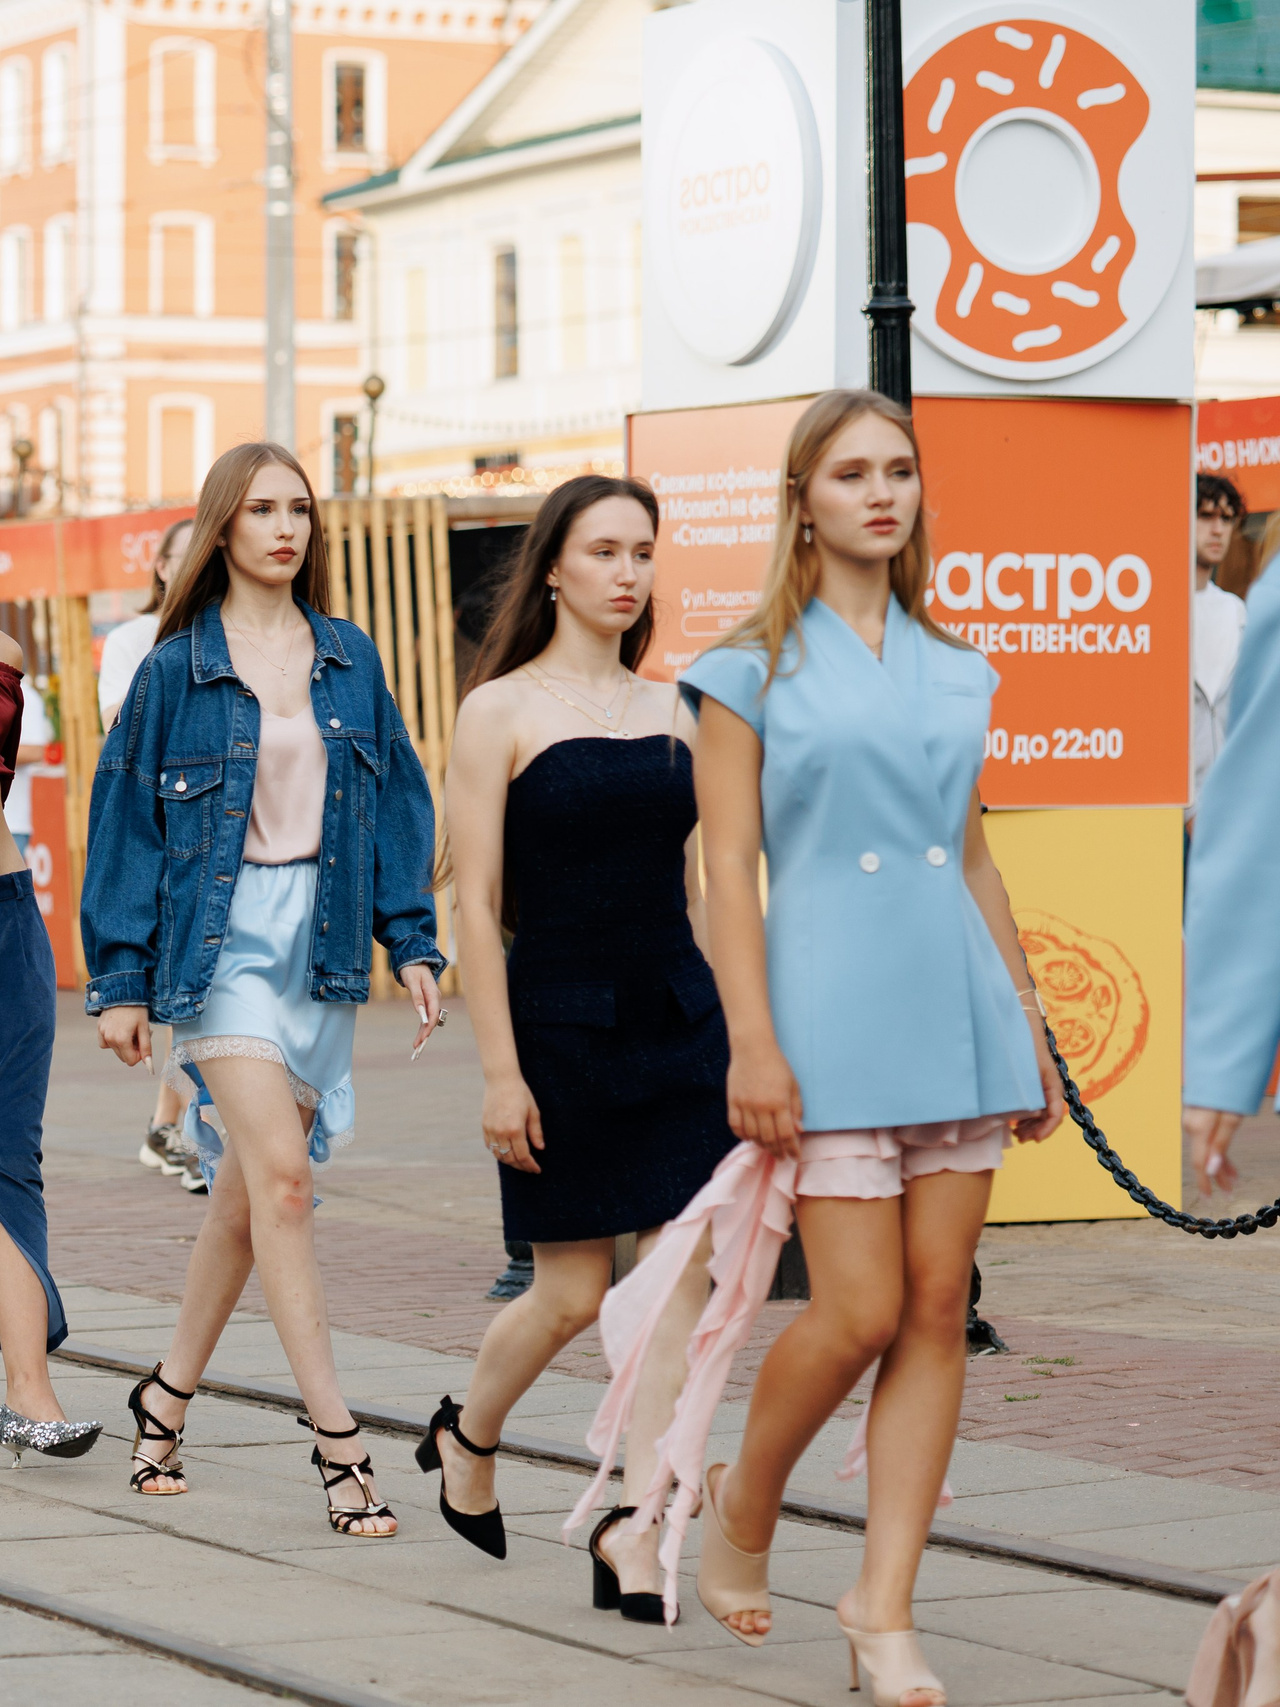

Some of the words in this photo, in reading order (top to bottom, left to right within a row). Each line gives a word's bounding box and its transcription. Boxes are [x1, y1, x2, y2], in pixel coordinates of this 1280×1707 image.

[679, 161, 771, 211] гастро
[1195, 442, 1223, 471] НО
[1237, 435, 1280, 468] НИЖ
[730, 498, 748, 518] на
[748, 492, 779, 521] фес
[740, 523, 778, 545] закат
[1011, 734, 1049, 765] до
[1051, 727, 1124, 760] 22:00
